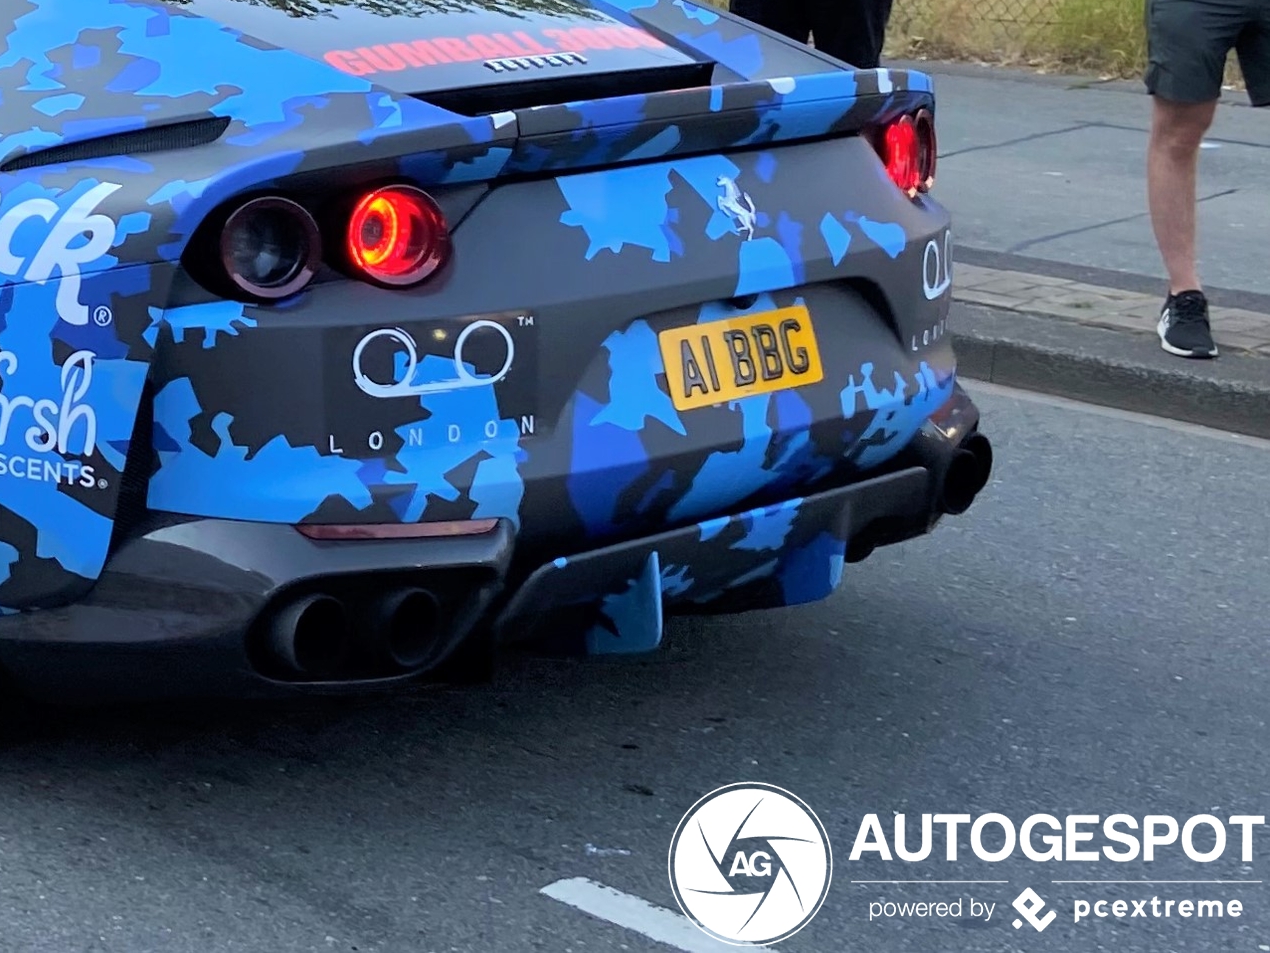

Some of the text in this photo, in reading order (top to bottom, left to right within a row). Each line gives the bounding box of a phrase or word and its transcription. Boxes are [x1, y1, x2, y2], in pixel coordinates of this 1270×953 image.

[323, 29, 556, 76] GUMBALL
[723, 318, 811, 388] BBG
[328, 414, 535, 454] LONDON
